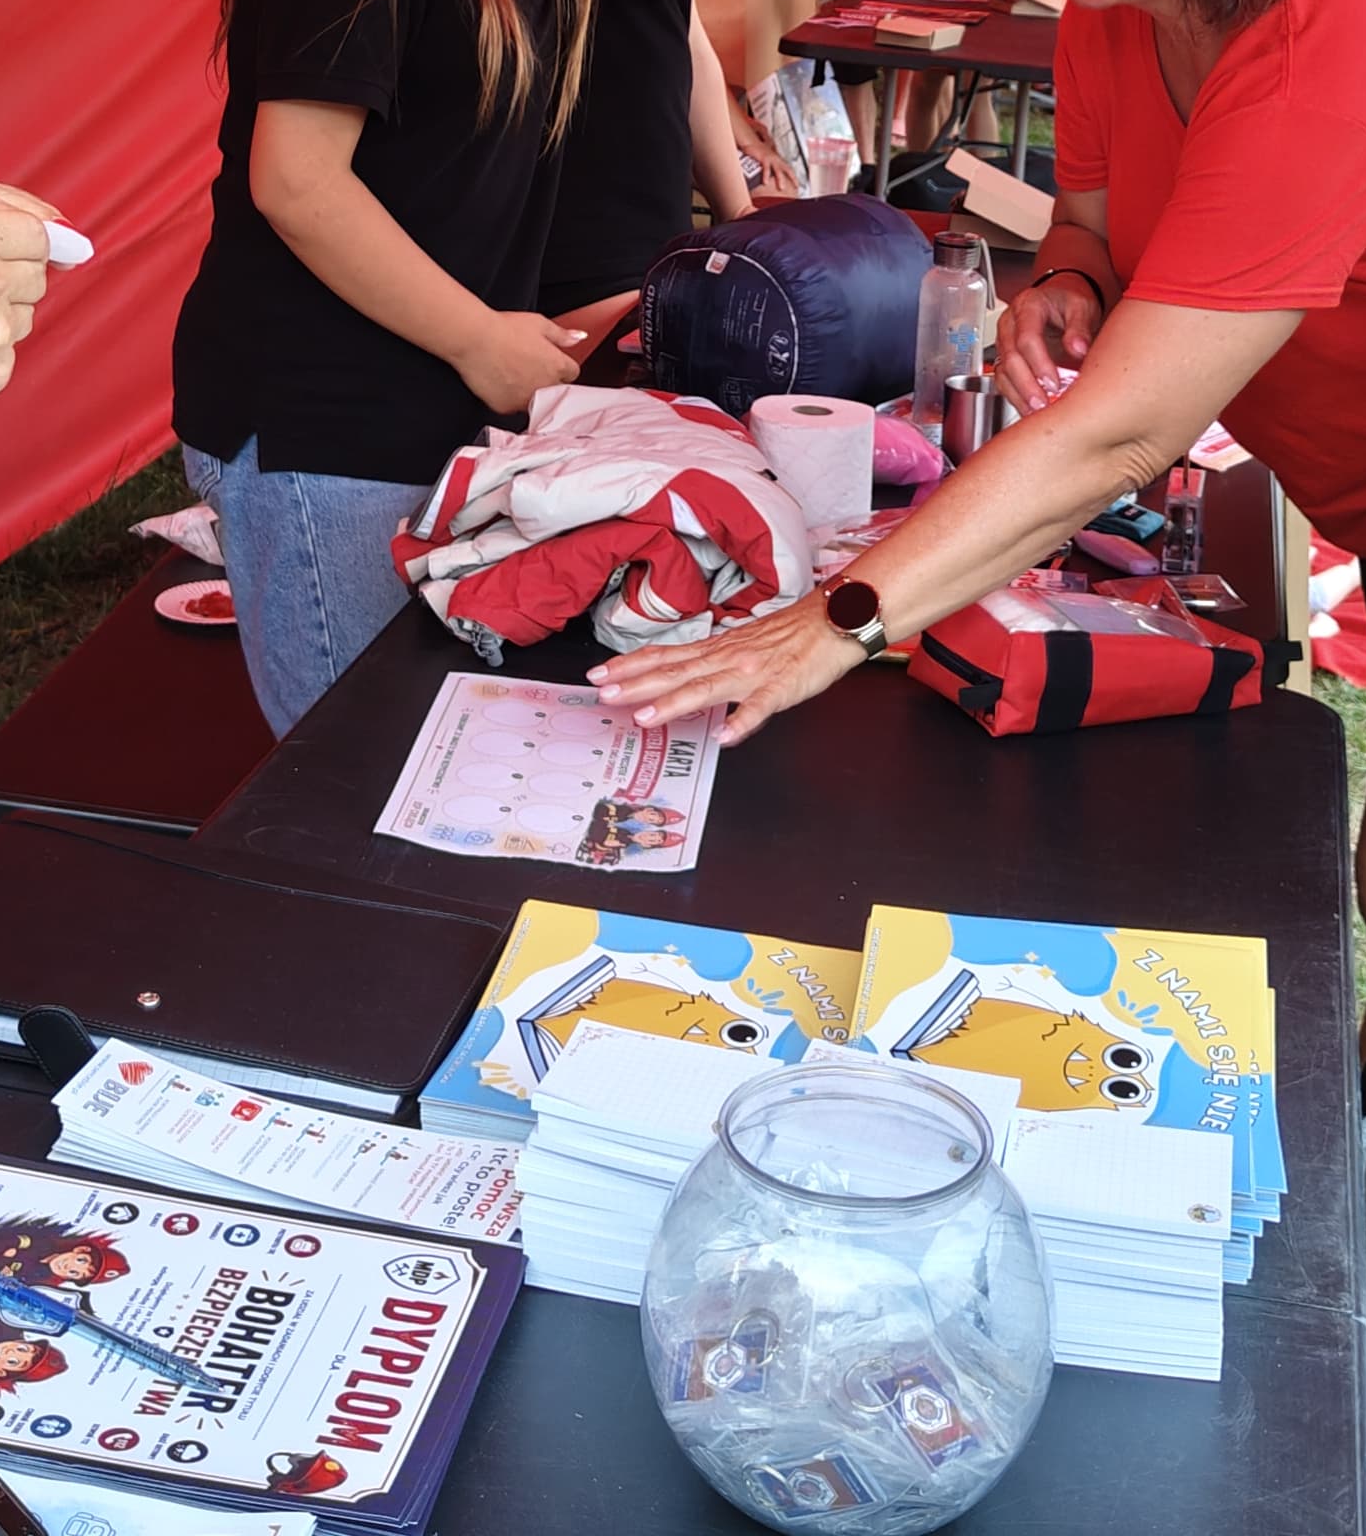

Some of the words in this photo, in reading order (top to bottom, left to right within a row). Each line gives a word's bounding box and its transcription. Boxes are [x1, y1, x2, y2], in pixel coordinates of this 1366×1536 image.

[662, 739, 696, 776] KARTA
[1133, 948, 1163, 972] Z
[767, 947, 797, 966] Z
[787, 966, 844, 1020] NAMI
[1156, 968, 1227, 1039] NAMI
[1202, 1044, 1240, 1087] SIĘ
[83, 1081, 127, 1118] BIJE
[1198, 1092, 1240, 1132] NIE
[474, 1164, 496, 1180] to
[438, 1180, 481, 1229] proste!
[407, 1259, 434, 1286] MDP
[132, 1267, 248, 1415] BEZPIECZETWA
[314, 1297, 448, 1452] DYPLOM
[327, 1353, 345, 1371] DLA
